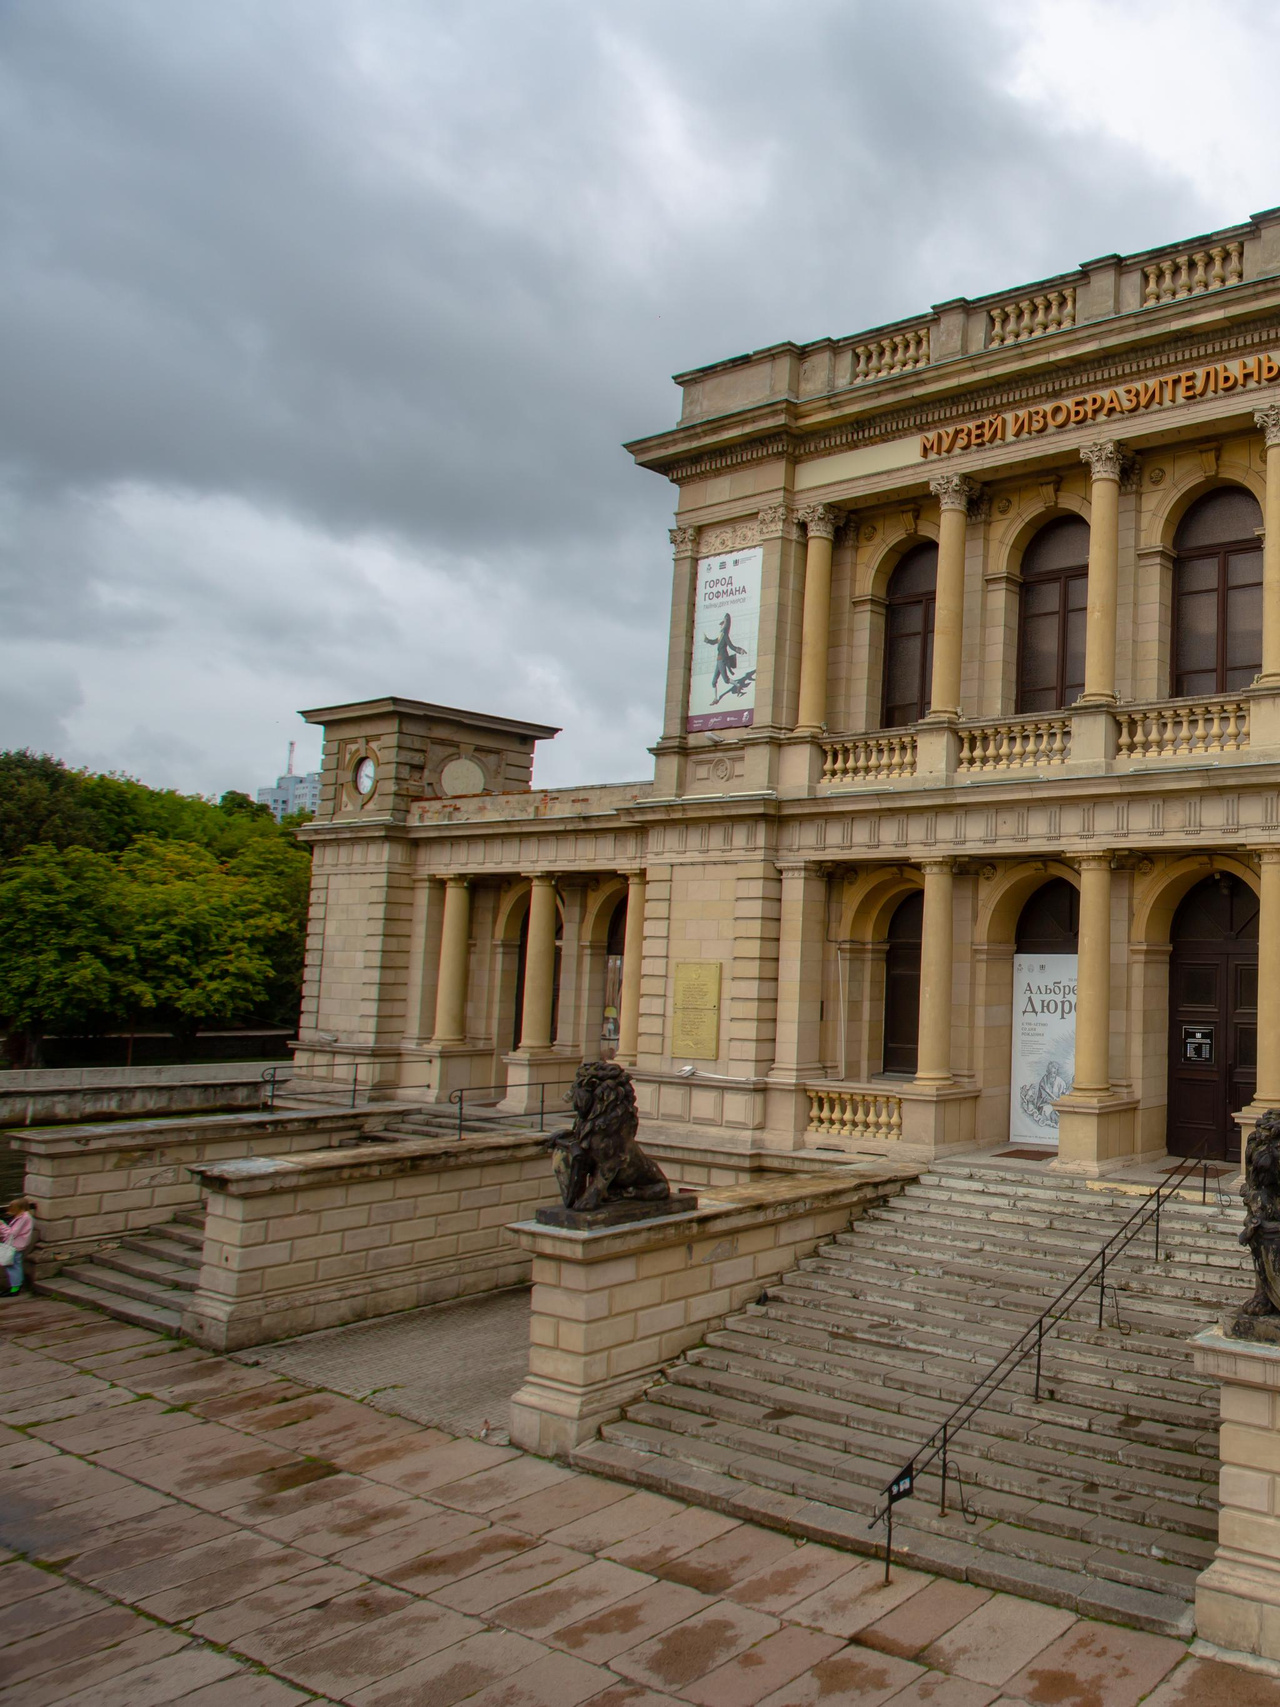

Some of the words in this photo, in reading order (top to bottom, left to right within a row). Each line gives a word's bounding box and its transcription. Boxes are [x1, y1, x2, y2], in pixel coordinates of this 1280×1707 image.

[920, 413, 1006, 459] МУЗЕЙ
[704, 576, 733, 589] ГОРОД
[703, 585, 747, 601] ГОФМАНА
[1022, 995, 1077, 1020] Дюр
